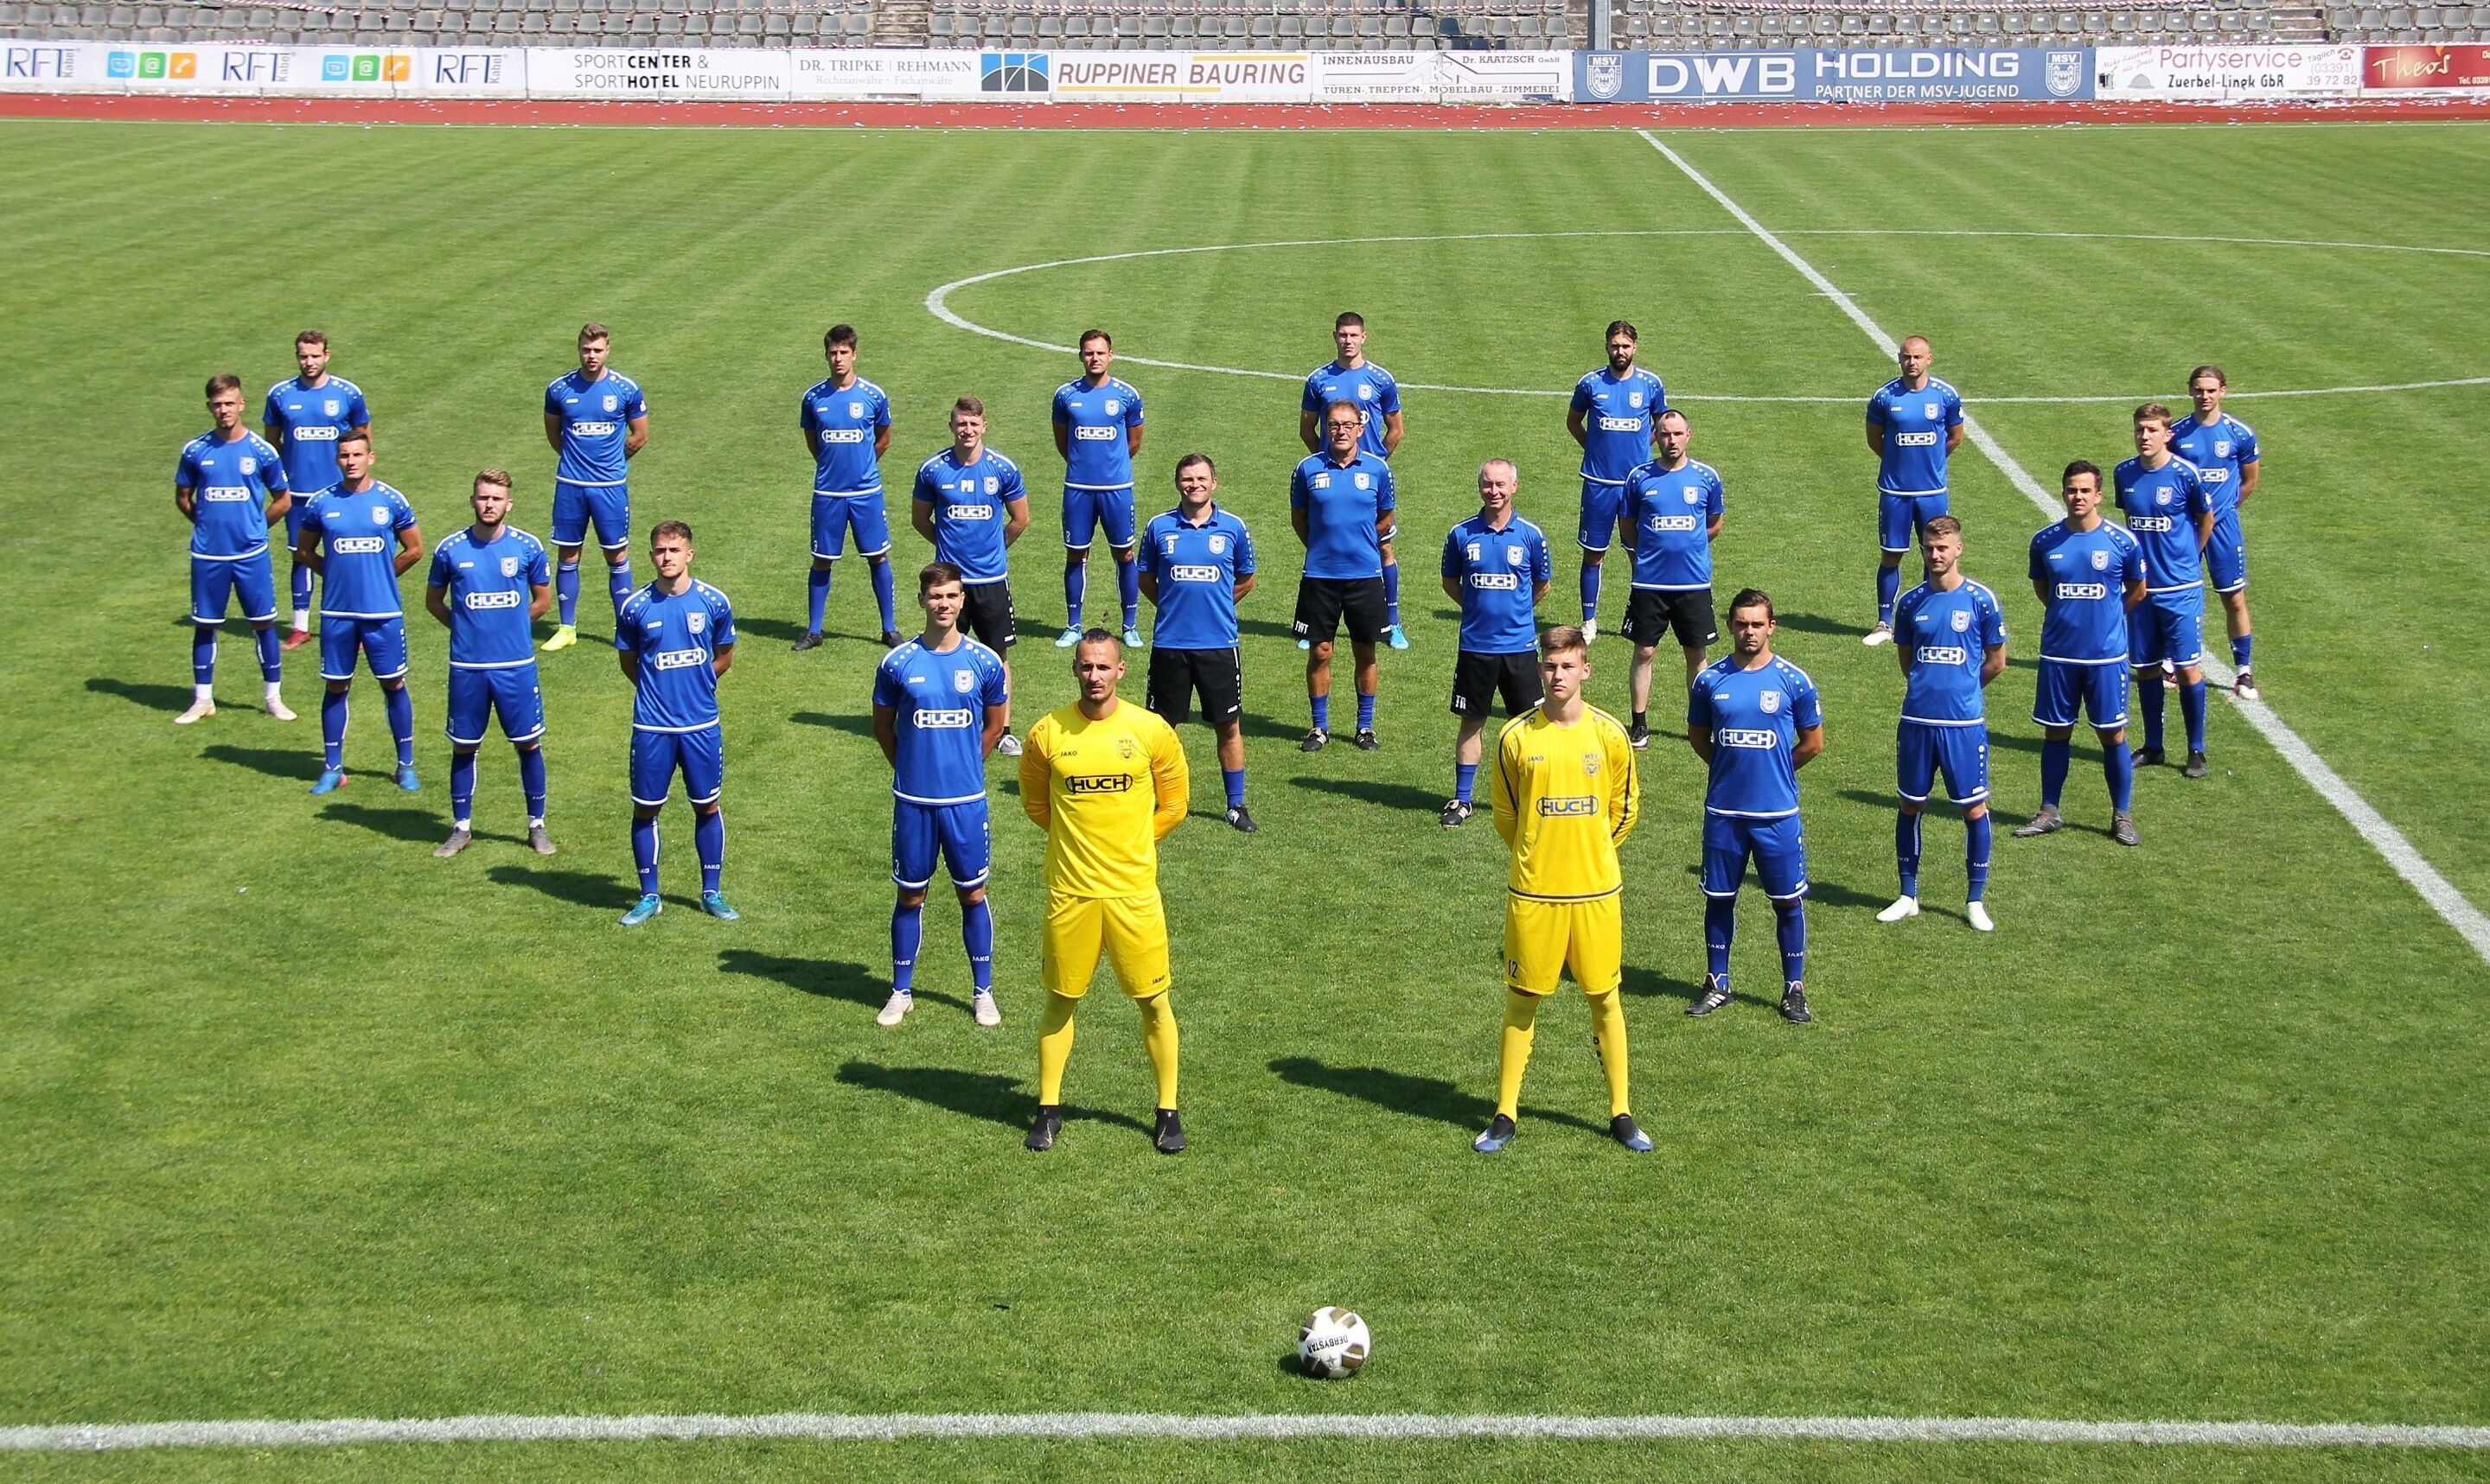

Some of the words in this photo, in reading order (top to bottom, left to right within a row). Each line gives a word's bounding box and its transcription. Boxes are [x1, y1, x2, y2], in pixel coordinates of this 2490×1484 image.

[574, 54, 692, 68] SPORTCENTER
[698, 54, 709, 68] &
[1323, 55, 1414, 66] INNENAUSBAU
[1479, 55, 1535, 64] KAATZSCH
[1592, 56, 1617, 66] MSV
[1816, 52, 2020, 78] HOLDING
[2051, 54, 2077, 63] MSV
[2161, 48, 2302, 73] Partyservice
[800, 60, 826, 72] DR.
[829, 60, 884, 72] TRIPKE
[897, 61, 972, 73] REHMANN
[1057, 63, 1177, 84] RUPPINER
[1189, 63, 1306, 84] BAURING
[575, 74, 680, 88] SPORTHOTEL
[686, 75, 779, 89] NEURUPPIN
[1648, 57, 1795, 94] DWB
[2168, 74, 2255, 90] Zuerbel-Lingk
[2261, 74, 2284, 87] GbR
[2307, 75, 2321, 86] 39
[2326, 75, 2339, 86] 72
[2343, 75, 2358, 85] 82
[1816, 85, 1883, 99] PARTNER
[1887, 85, 1916, 99] DER
[1921, 85, 2019, 98] MSV-JUGEND
[1315, 477, 1331, 489] TWT
[1467, 549, 1480, 561] TR
[1306, 1334, 1349, 1353] DERBYSTAR
